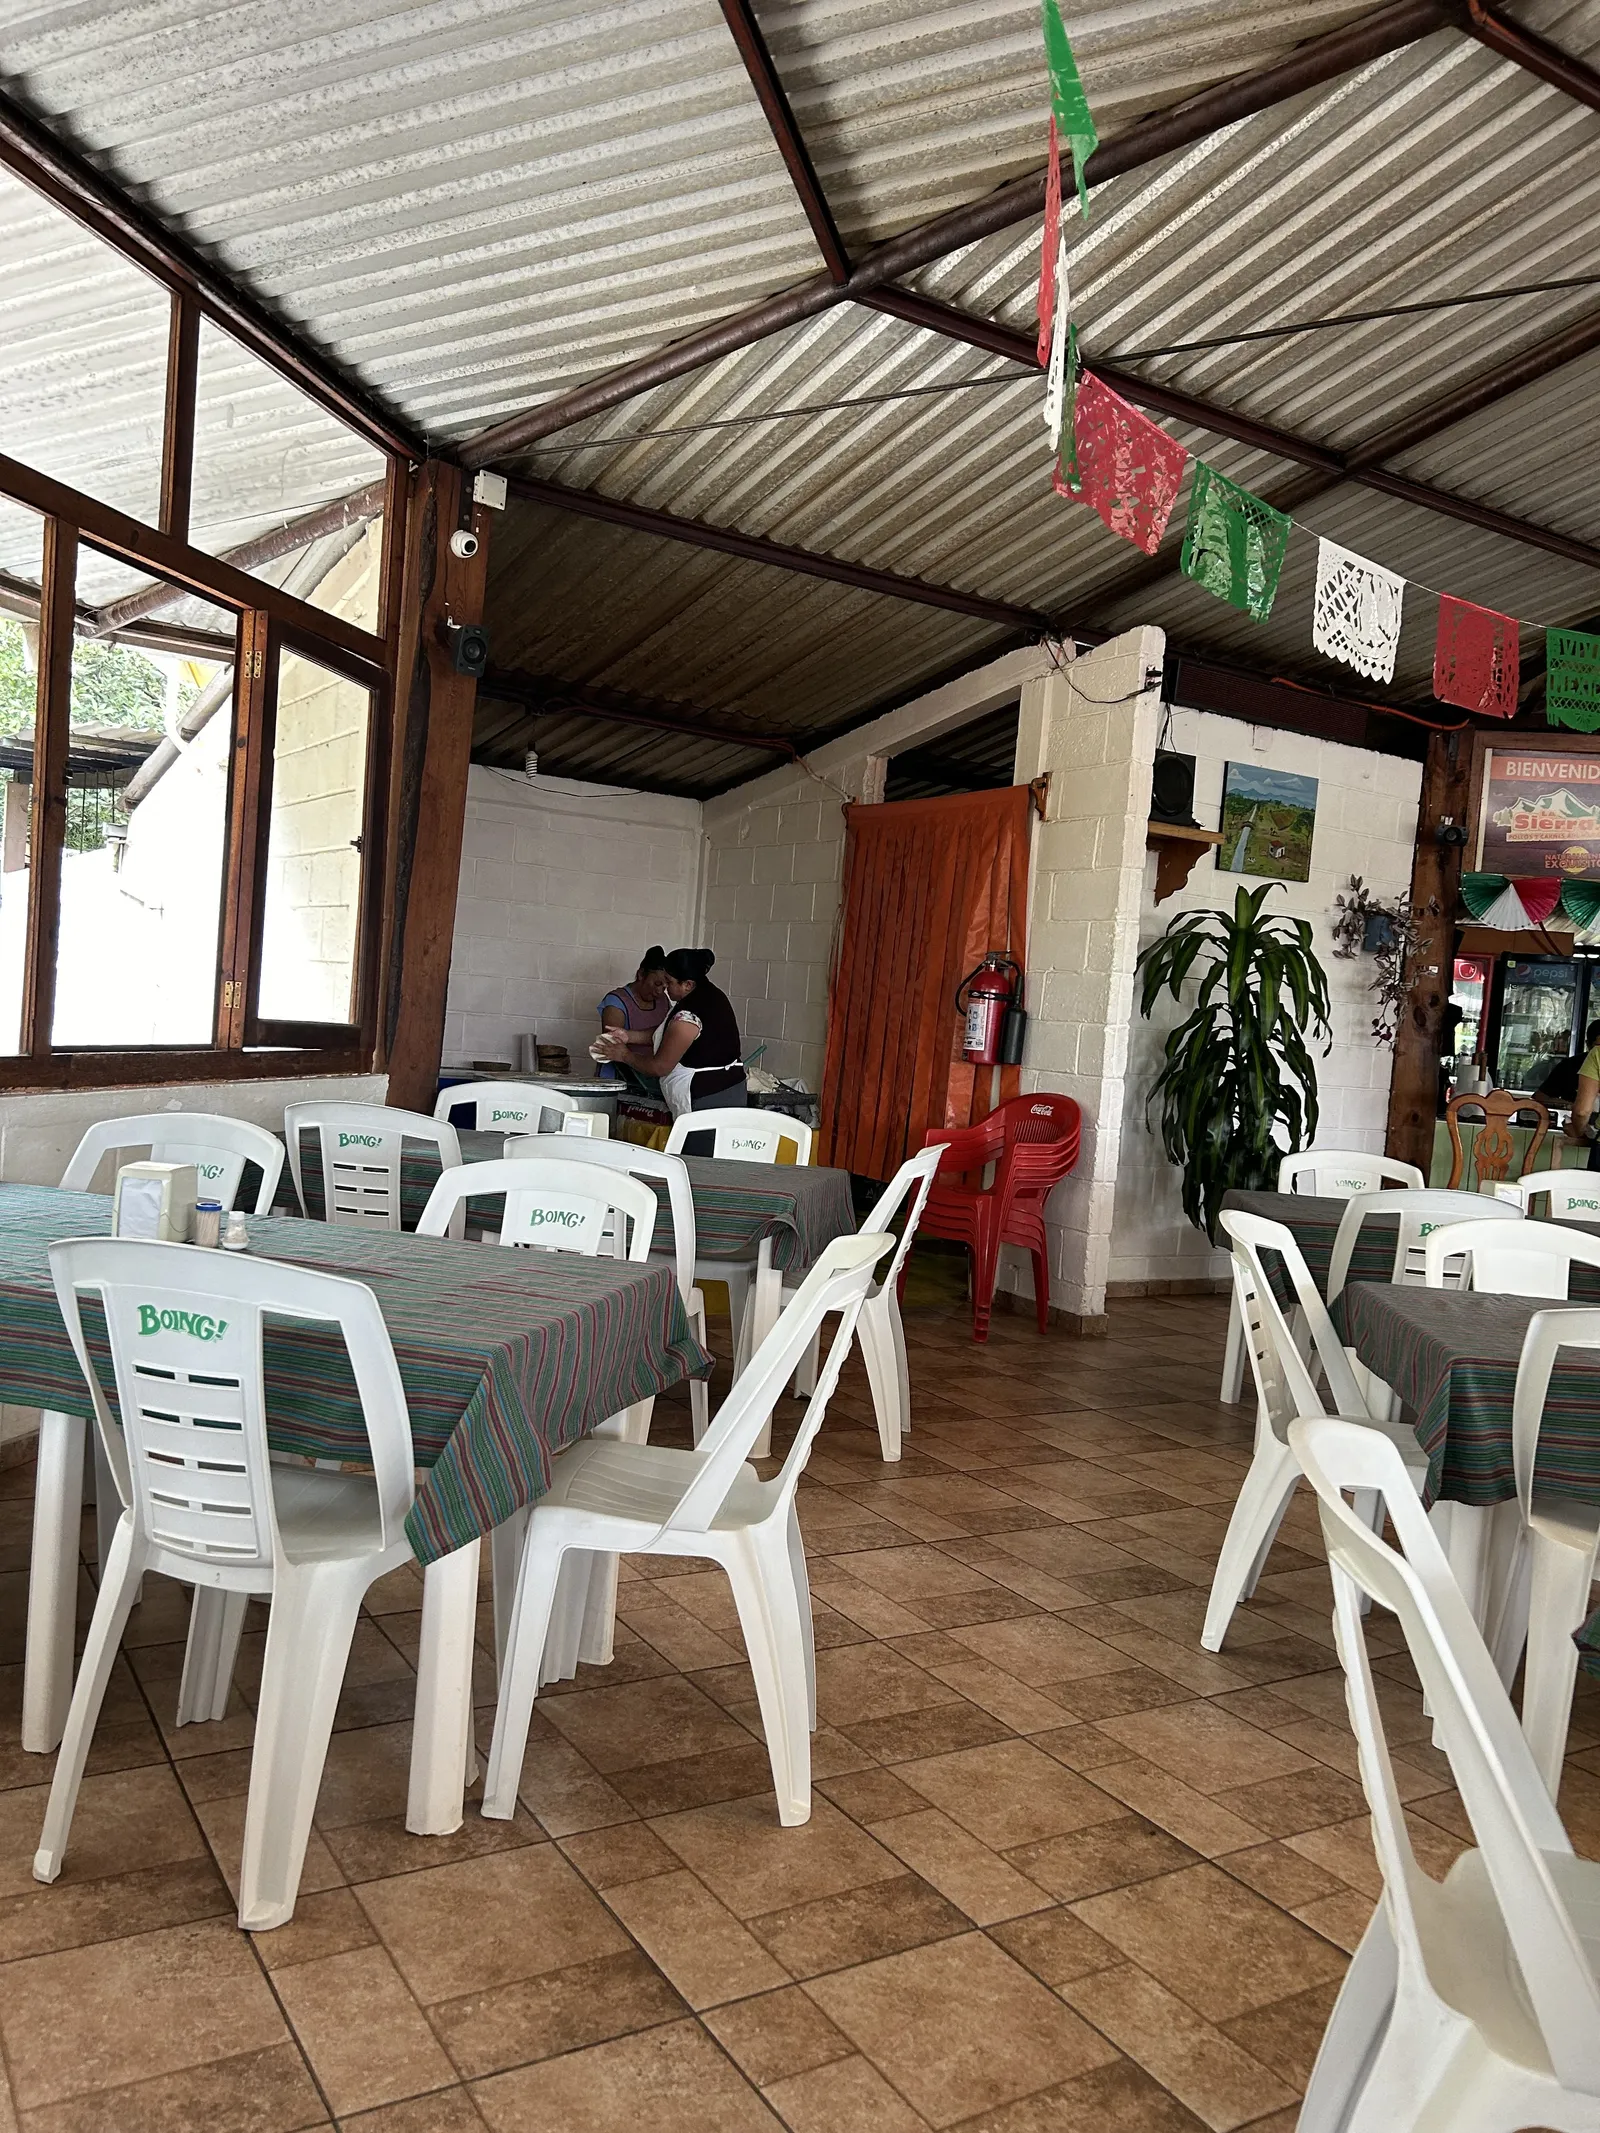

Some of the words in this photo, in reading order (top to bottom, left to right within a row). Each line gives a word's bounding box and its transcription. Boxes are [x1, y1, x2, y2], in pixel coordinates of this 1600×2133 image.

[1506, 761, 1600, 779] BIENVENID
[1541, 809, 1556, 817] LA
[1514, 813, 1595, 830] Sierra
[1533, 967, 1568, 979] pepsi
[491, 1109, 529, 1122] BOING!
[338, 1132, 383, 1148] BOING!
[1566, 1197, 1600, 1211] BOING
[529, 1208, 587, 1229] BOING!
[137, 1304, 229, 1342] BOING!
